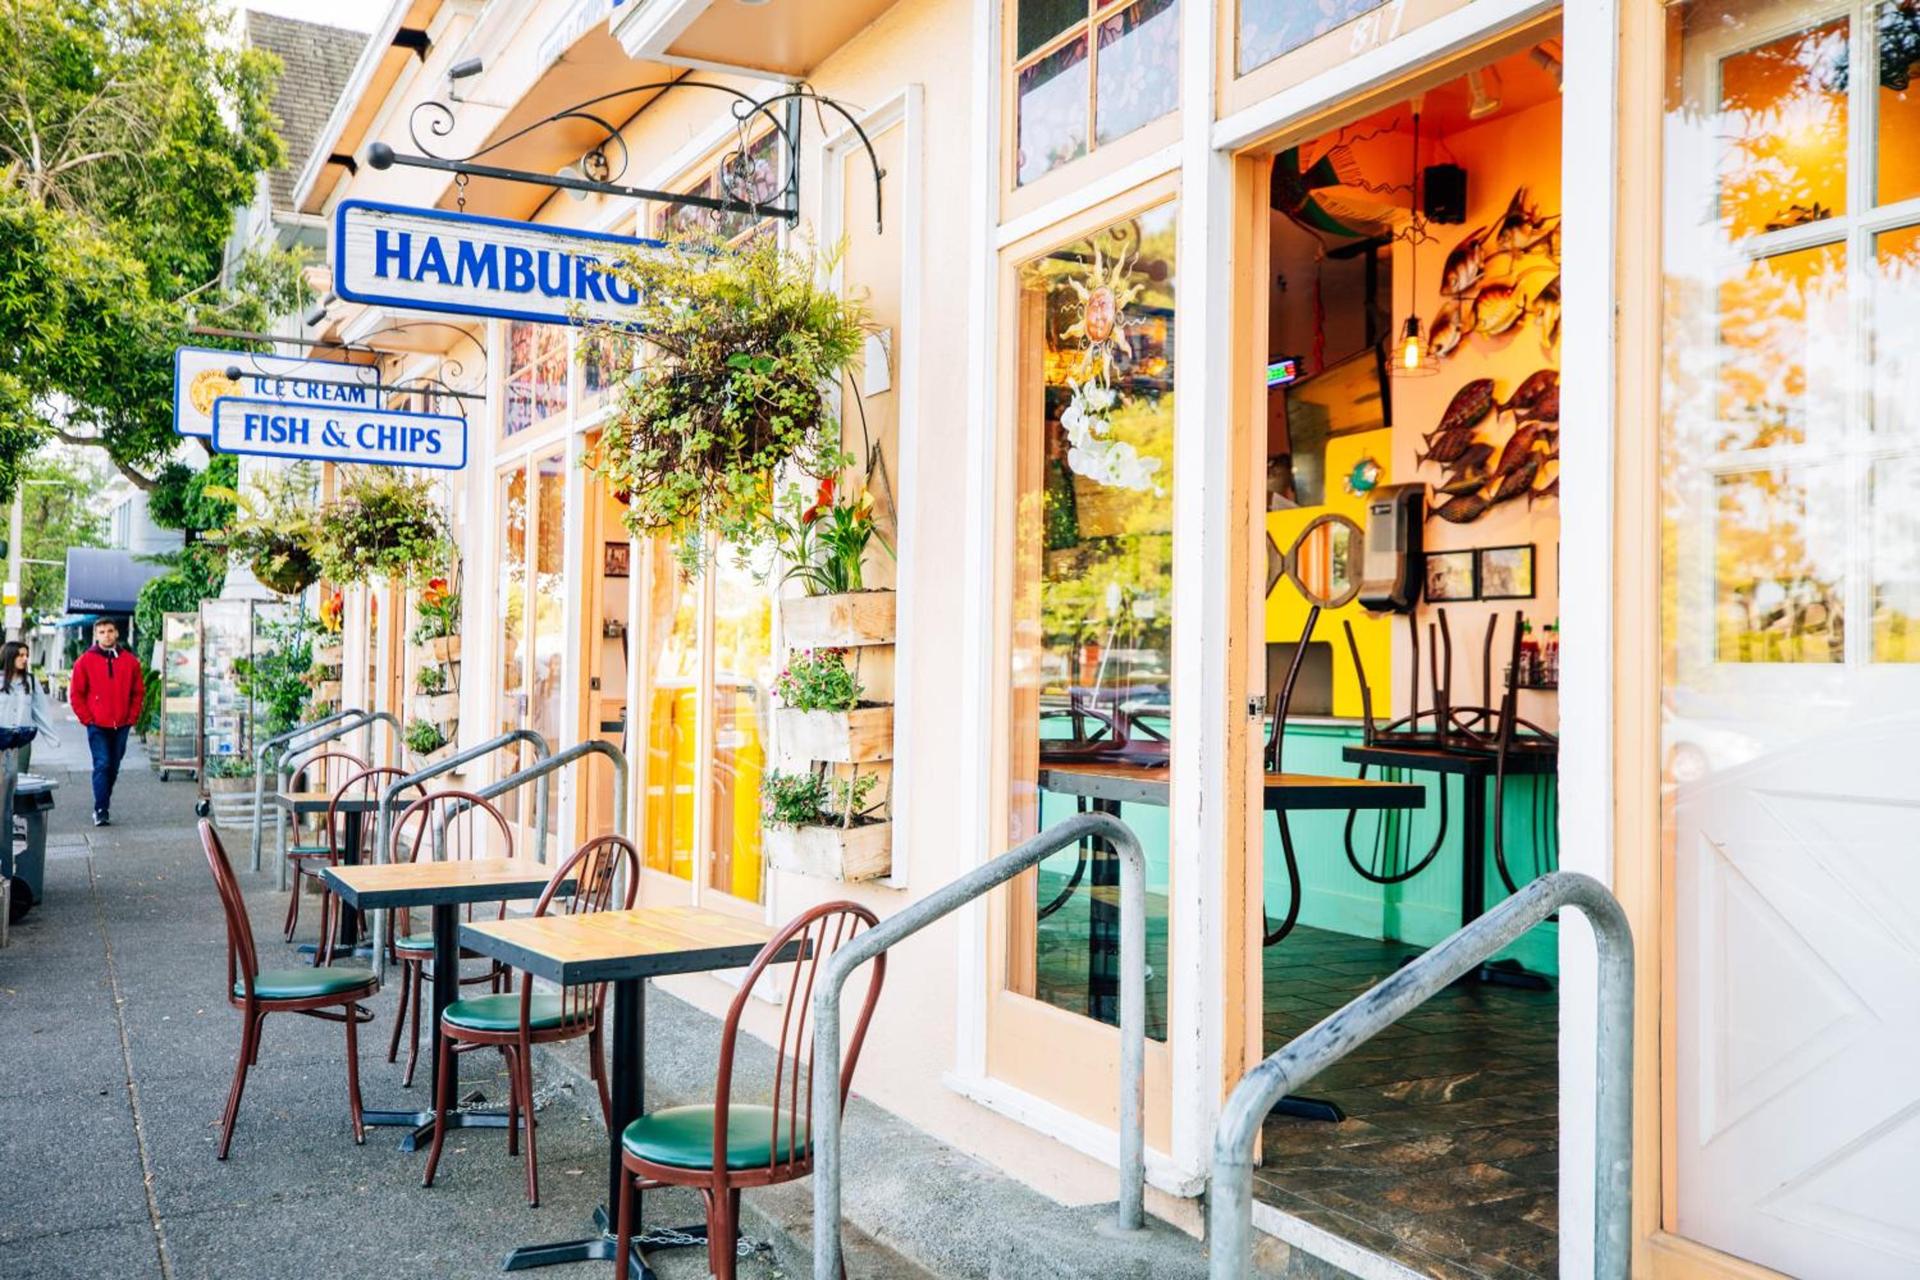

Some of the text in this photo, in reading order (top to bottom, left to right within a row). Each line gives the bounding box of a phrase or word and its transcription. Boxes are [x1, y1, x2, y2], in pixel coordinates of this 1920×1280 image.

[1349, 0, 1405, 53] 817
[374, 229, 652, 305] HAMBURG
[254, 376, 285, 396] ICE
[293, 381, 366, 403] CREAM
[244, 413, 441, 454] FISH & CHIPS
